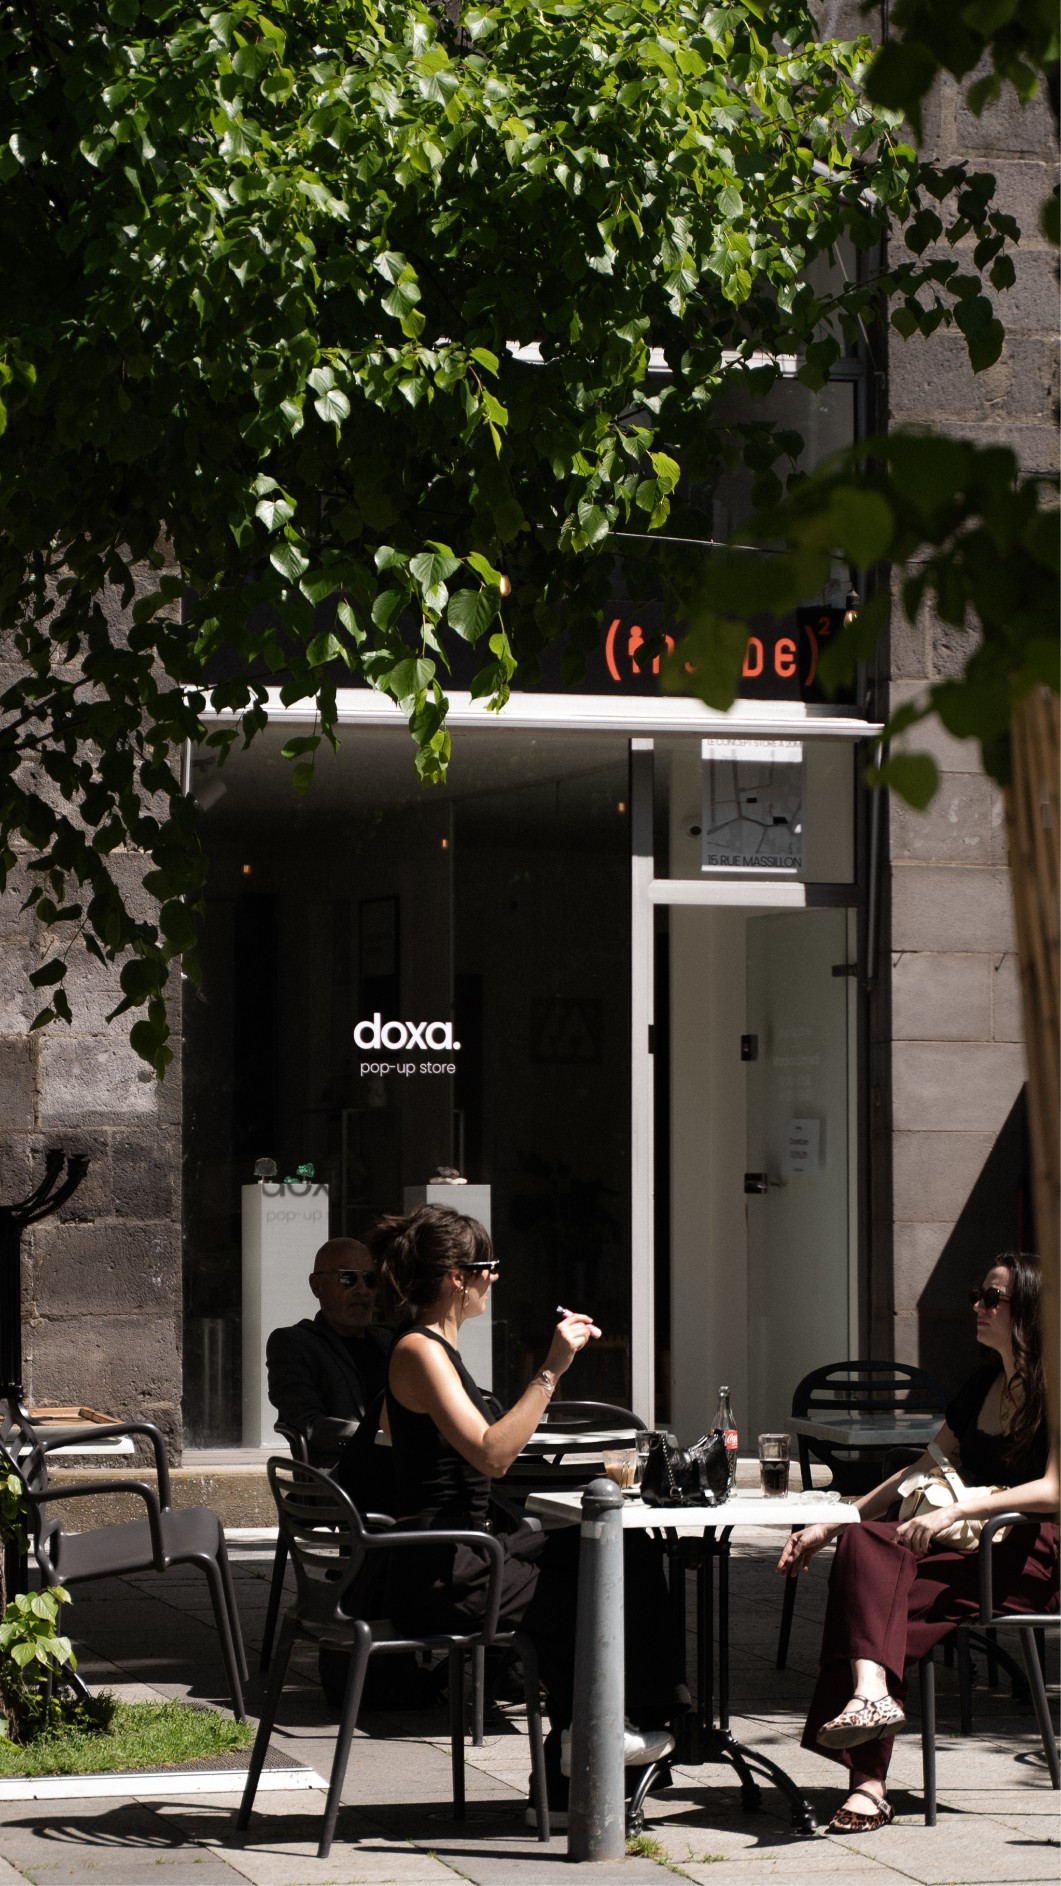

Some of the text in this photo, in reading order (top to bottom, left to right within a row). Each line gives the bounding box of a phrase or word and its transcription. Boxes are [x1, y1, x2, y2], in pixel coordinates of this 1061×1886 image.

[707, 854, 802, 868] 15 RUE MASSILLON
[353, 1012, 461, 1050] doxa.
[360, 1061, 456, 1077] pop-up store
